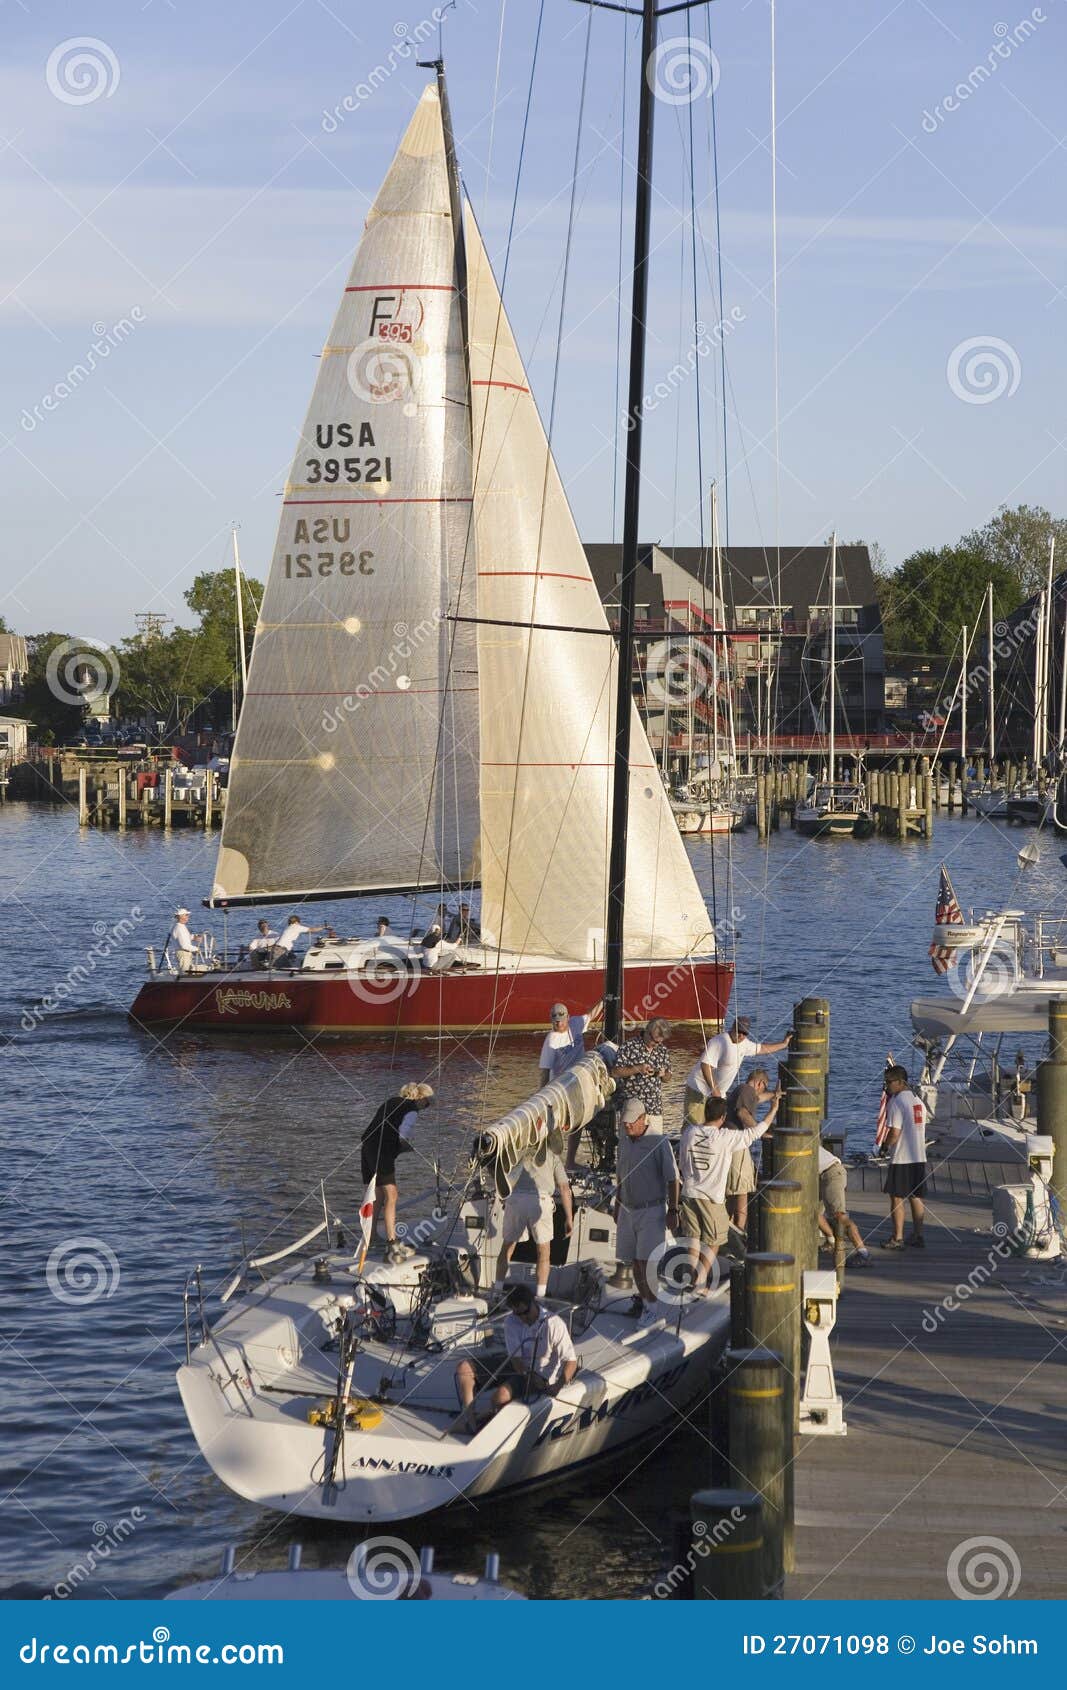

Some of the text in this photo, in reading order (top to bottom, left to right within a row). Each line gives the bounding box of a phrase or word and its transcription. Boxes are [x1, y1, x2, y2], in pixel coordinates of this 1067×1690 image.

[379, 322, 412, 343] 395
[316, 422, 375, 449] USA
[306, 457, 391, 484] 39521
[351, 1456, 455, 1478] ANNAPOLIS
